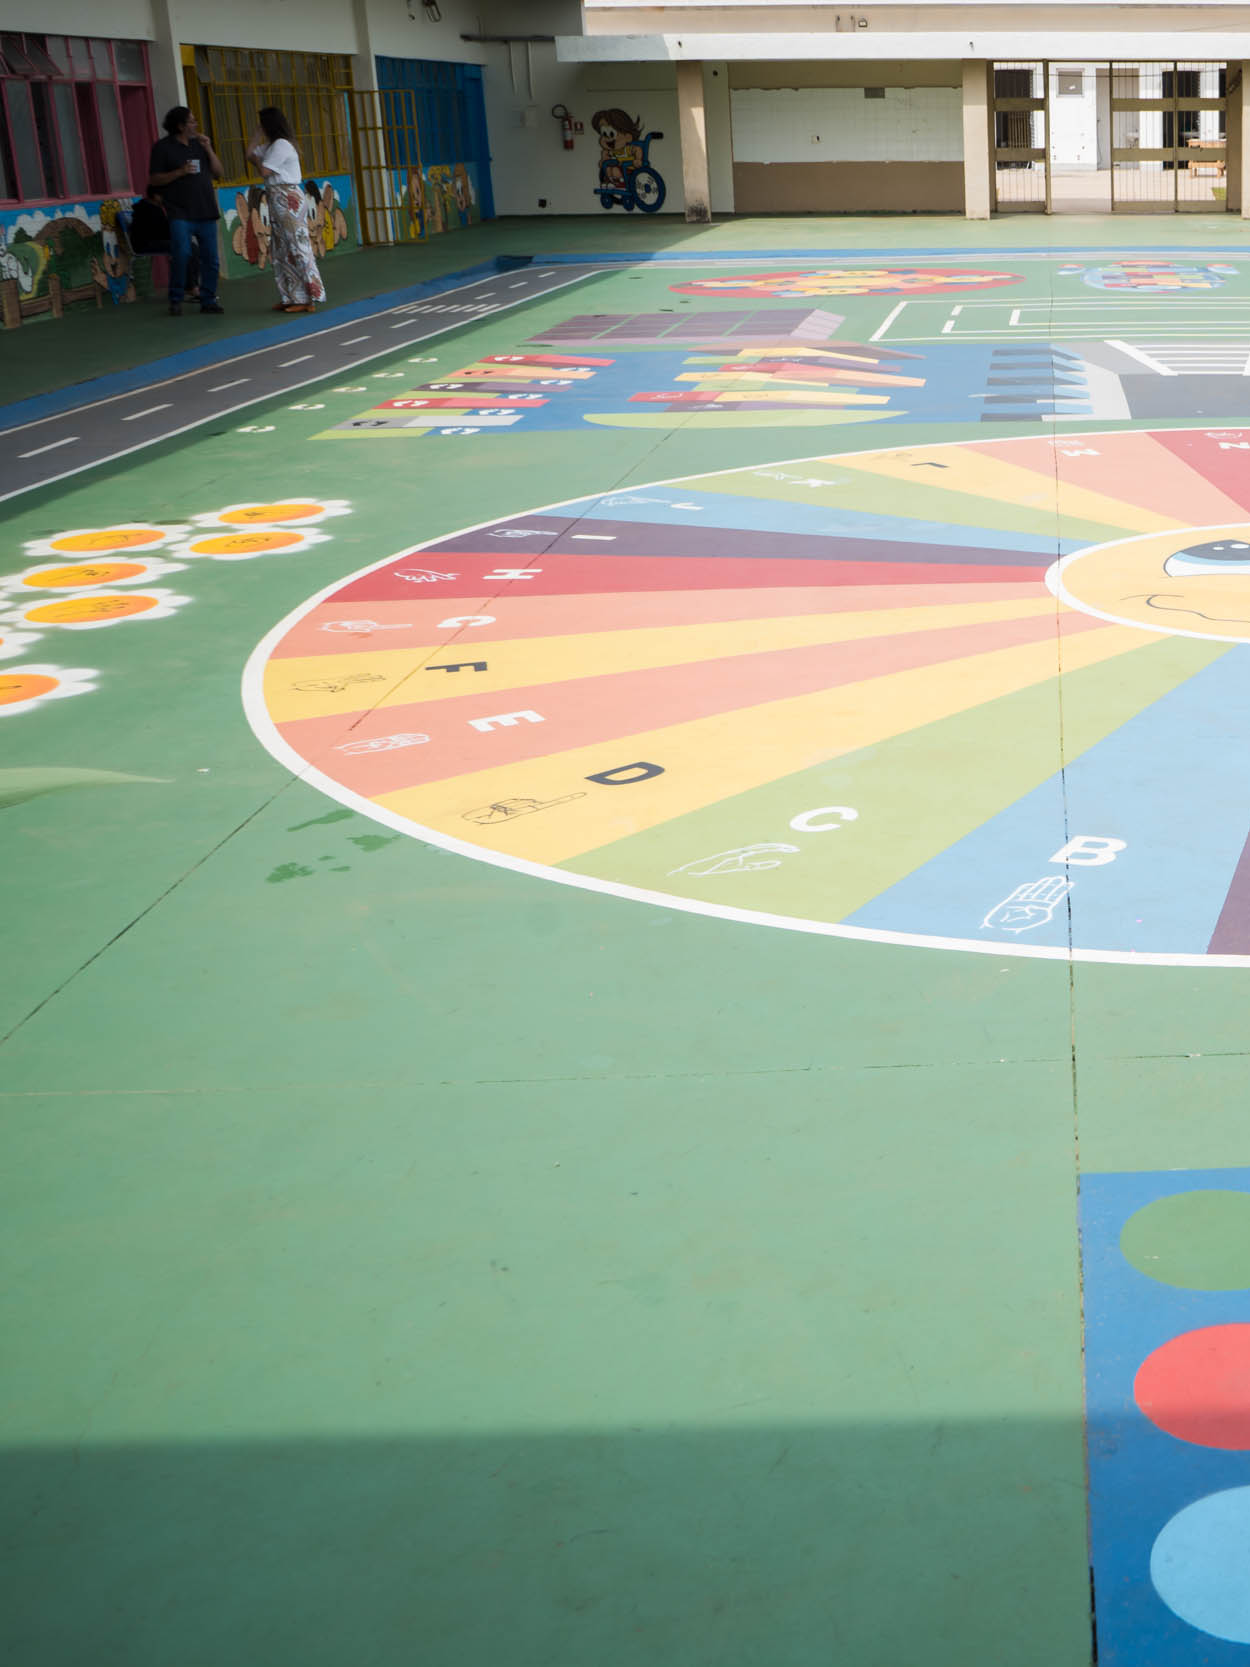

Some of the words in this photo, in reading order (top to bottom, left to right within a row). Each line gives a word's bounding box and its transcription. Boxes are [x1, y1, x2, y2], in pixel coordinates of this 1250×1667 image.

[483, 568, 543, 580] H
[425, 661, 488, 673] F
[466, 710, 546, 732] E
[584, 761, 665, 786] D
[789, 806, 858, 832] C
[1048, 835, 1128, 868] B
